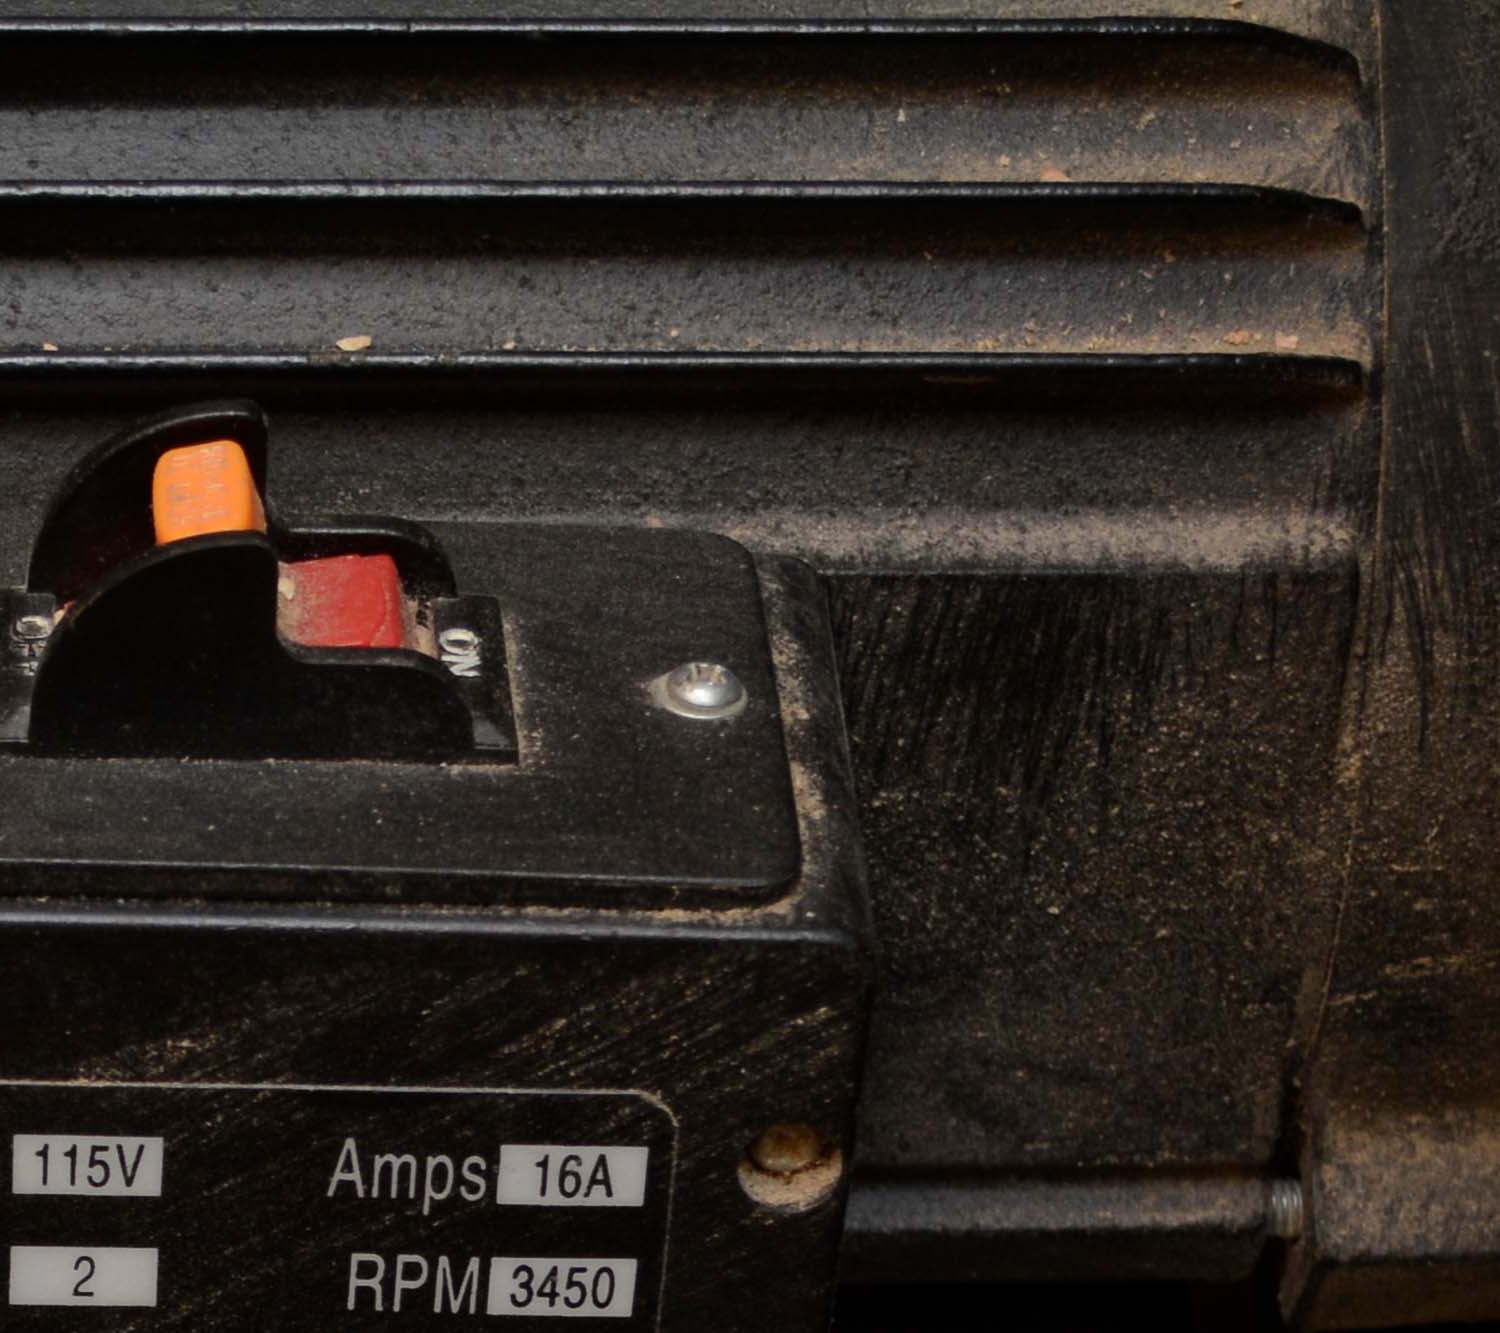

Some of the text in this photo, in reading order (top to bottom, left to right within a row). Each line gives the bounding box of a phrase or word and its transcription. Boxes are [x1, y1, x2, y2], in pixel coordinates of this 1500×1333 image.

[439, 628, 481, 677] ON
[35, 1143, 145, 1188] 115V
[326, 1137, 614, 1216] Amps 16A
[71, 1255, 96, 1298] 2
[346, 1252, 616, 1315] RPM 3450
